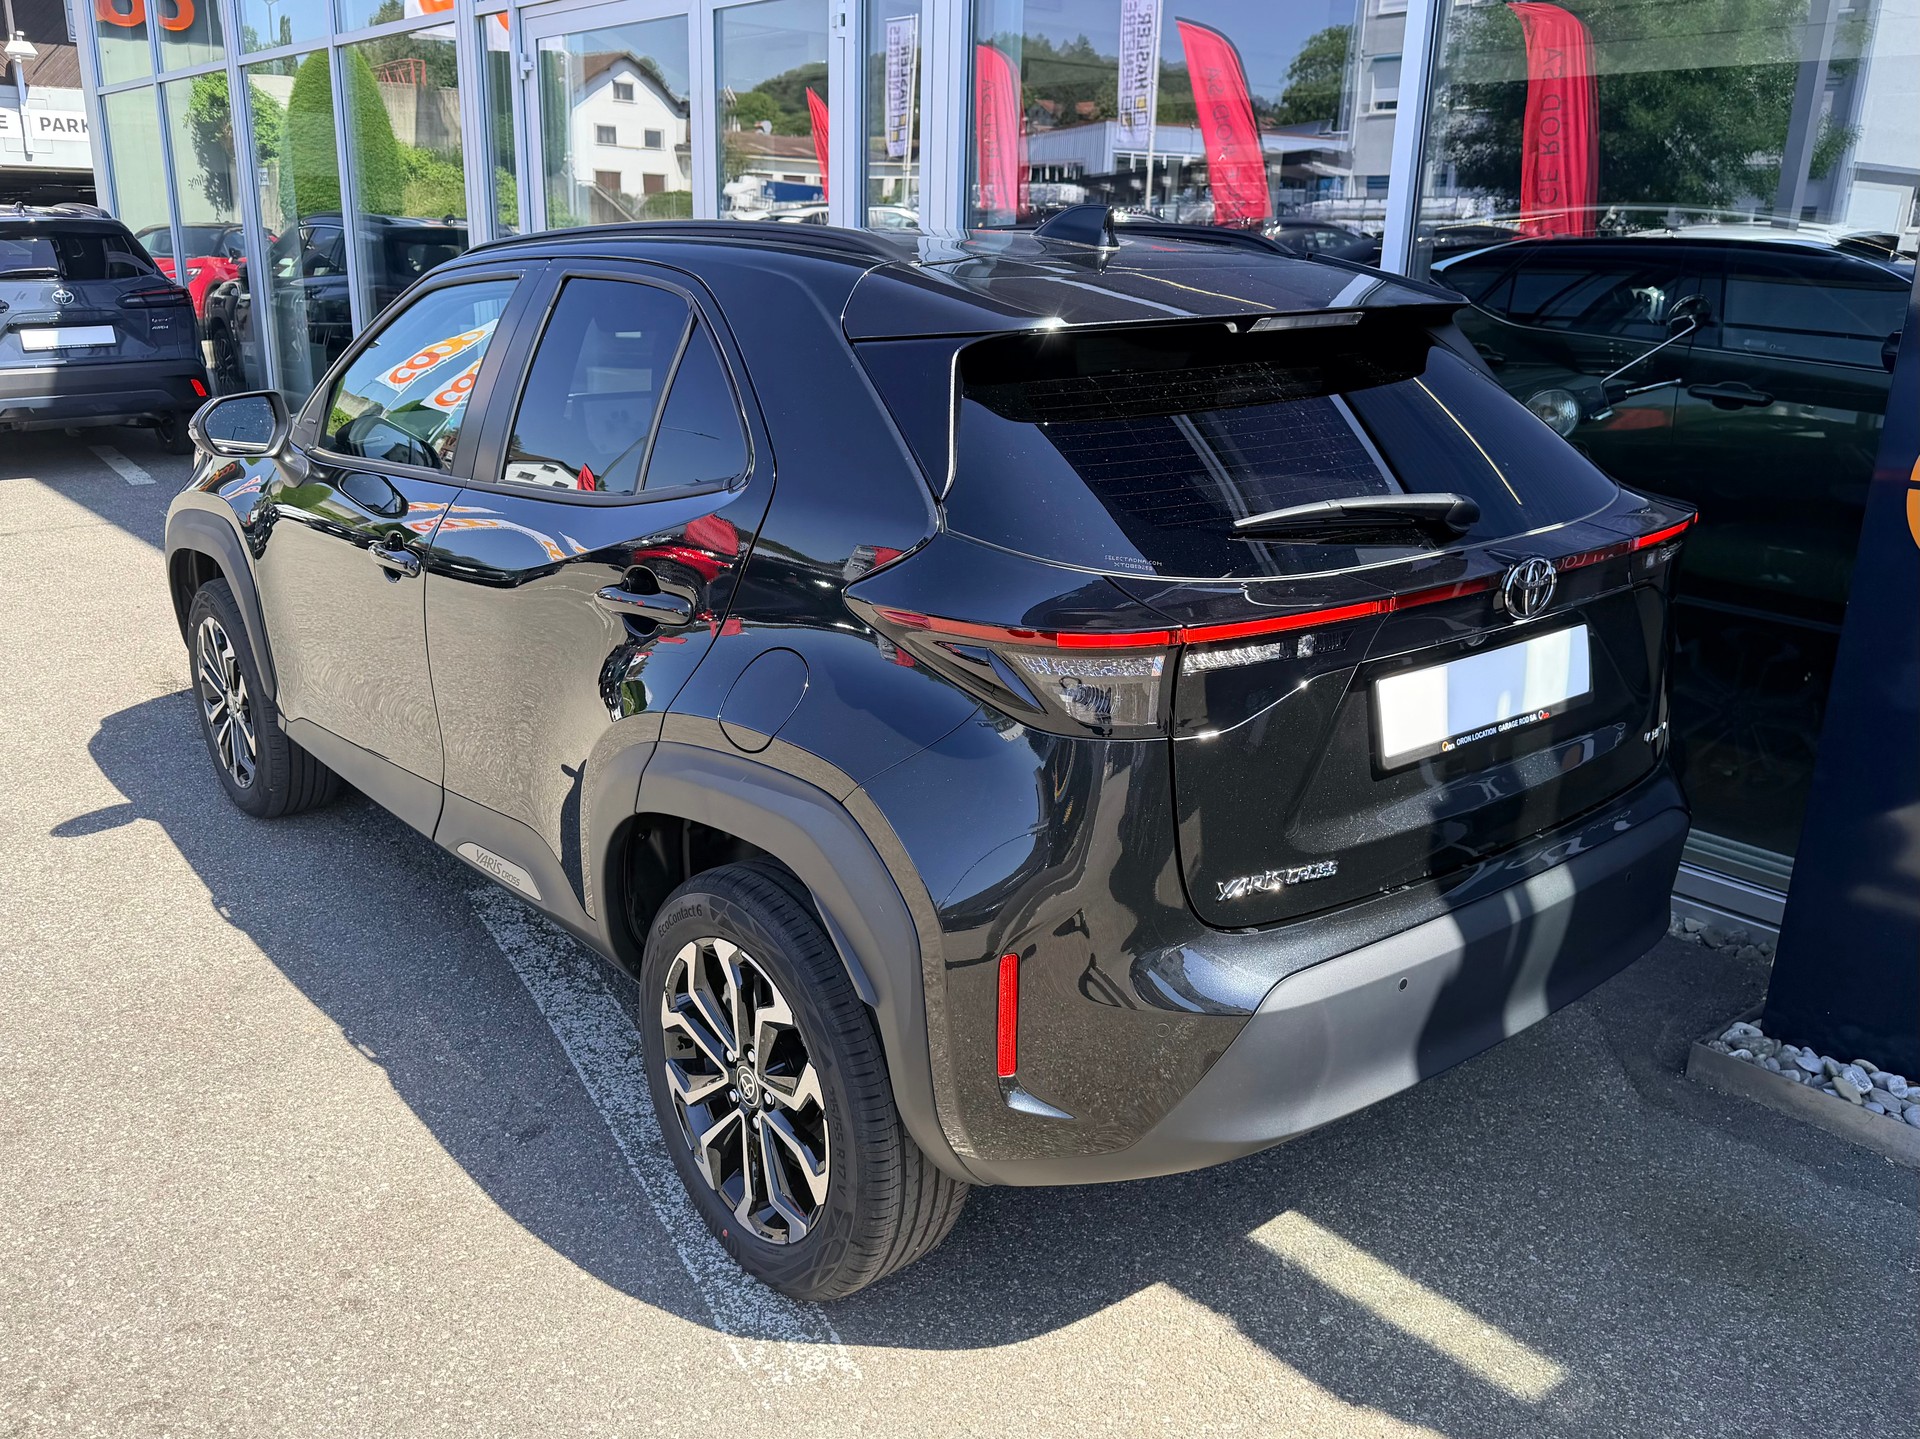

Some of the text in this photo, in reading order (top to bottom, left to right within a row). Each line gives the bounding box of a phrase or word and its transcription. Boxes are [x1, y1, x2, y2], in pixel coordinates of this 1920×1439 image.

[1456, 735, 1472, 746] ORON
[1472, 726, 1497, 741] LOCATION
[1498, 719, 1519, 732] GARAGE
[1519, 715, 1530, 725] ROD
[502, 869, 520, 887] CROSS
[657, 904, 703, 938] EcoContact 6
[836, 1147, 846, 1159] R
[836, 1163, 847, 1180] 17
[836, 1183, 847, 1198] V
